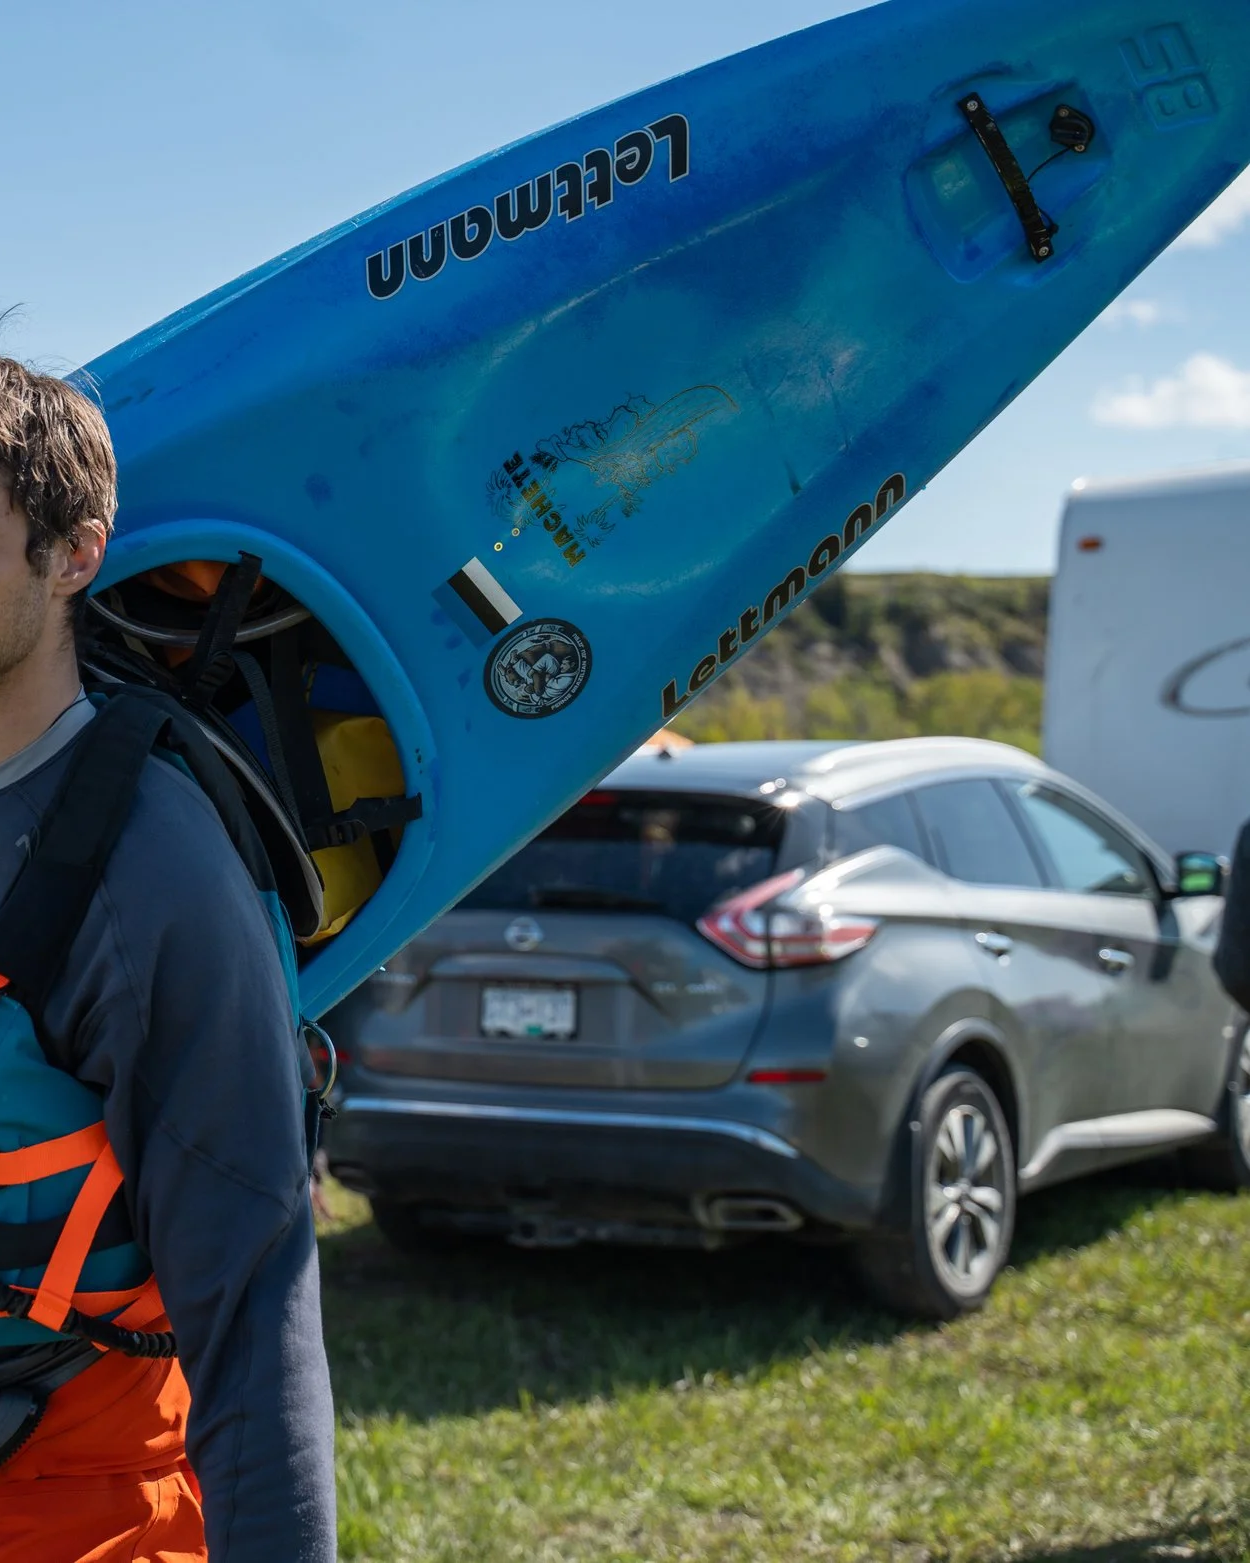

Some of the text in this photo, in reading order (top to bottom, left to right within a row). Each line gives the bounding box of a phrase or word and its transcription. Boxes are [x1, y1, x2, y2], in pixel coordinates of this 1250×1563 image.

[365, 113, 690, 299] Lettmann
[503, 451, 586, 567] MACHETE
[661, 472, 906, 720] Lettmann
